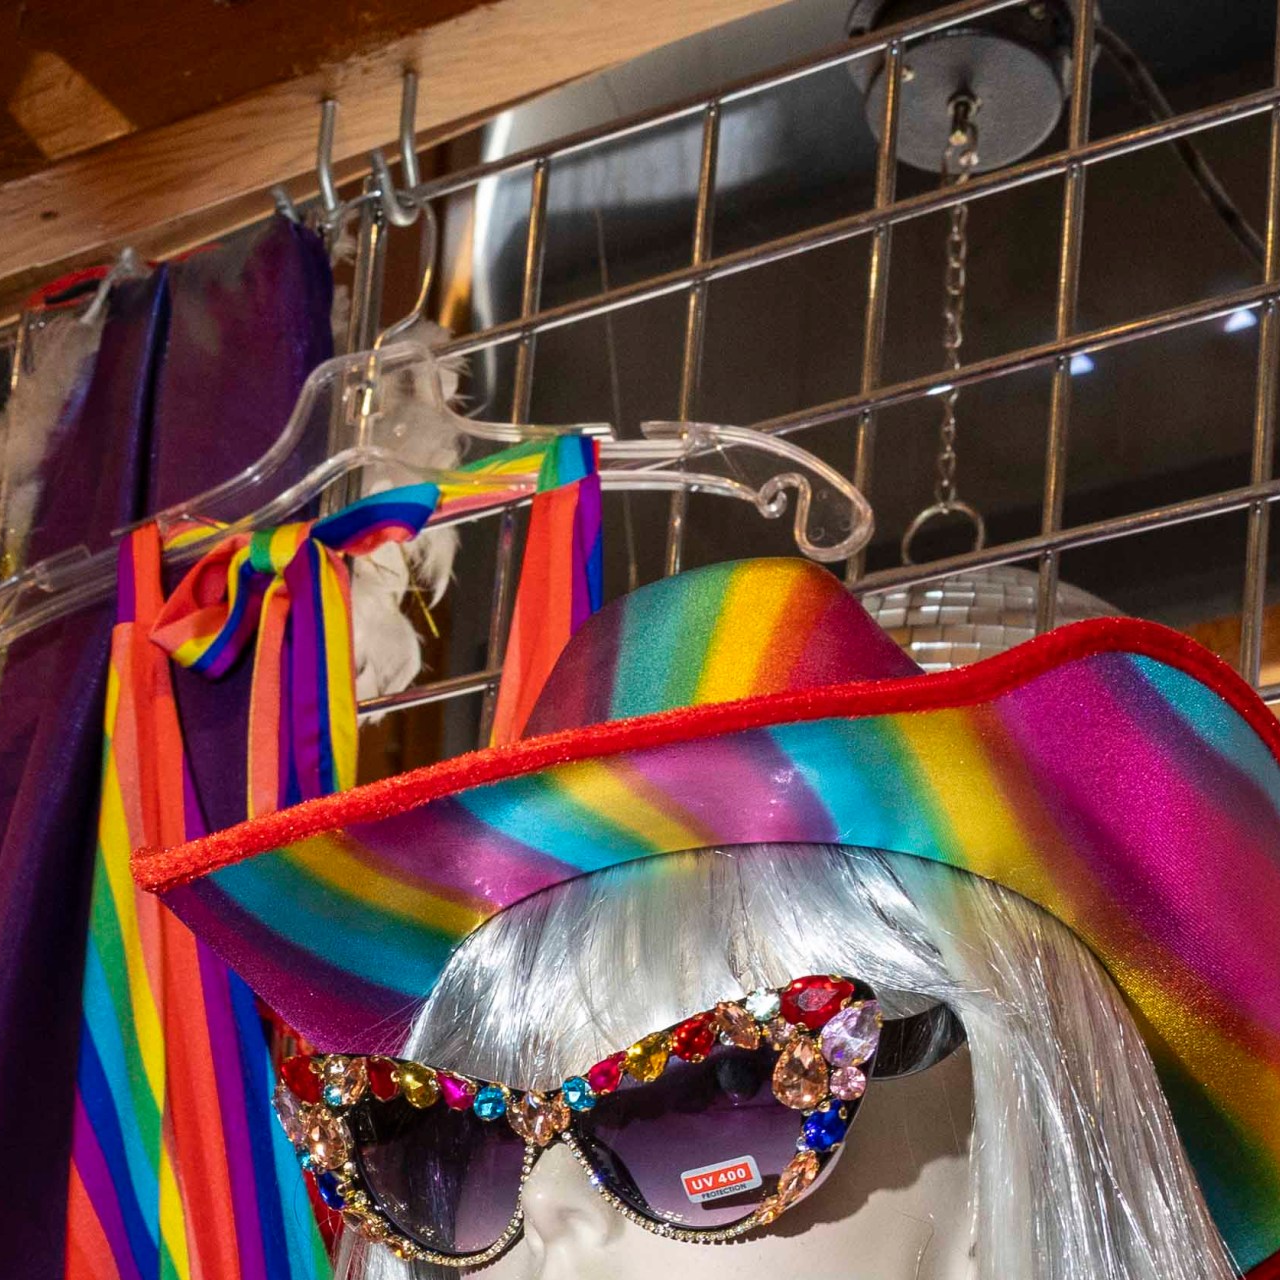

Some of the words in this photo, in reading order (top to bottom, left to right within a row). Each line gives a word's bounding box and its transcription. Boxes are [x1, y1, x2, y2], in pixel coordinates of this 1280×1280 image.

[691, 1176, 714, 1191] UV
[718, 1167, 747, 1184] 400
[701, 1183, 748, 1200] PROTECTION
